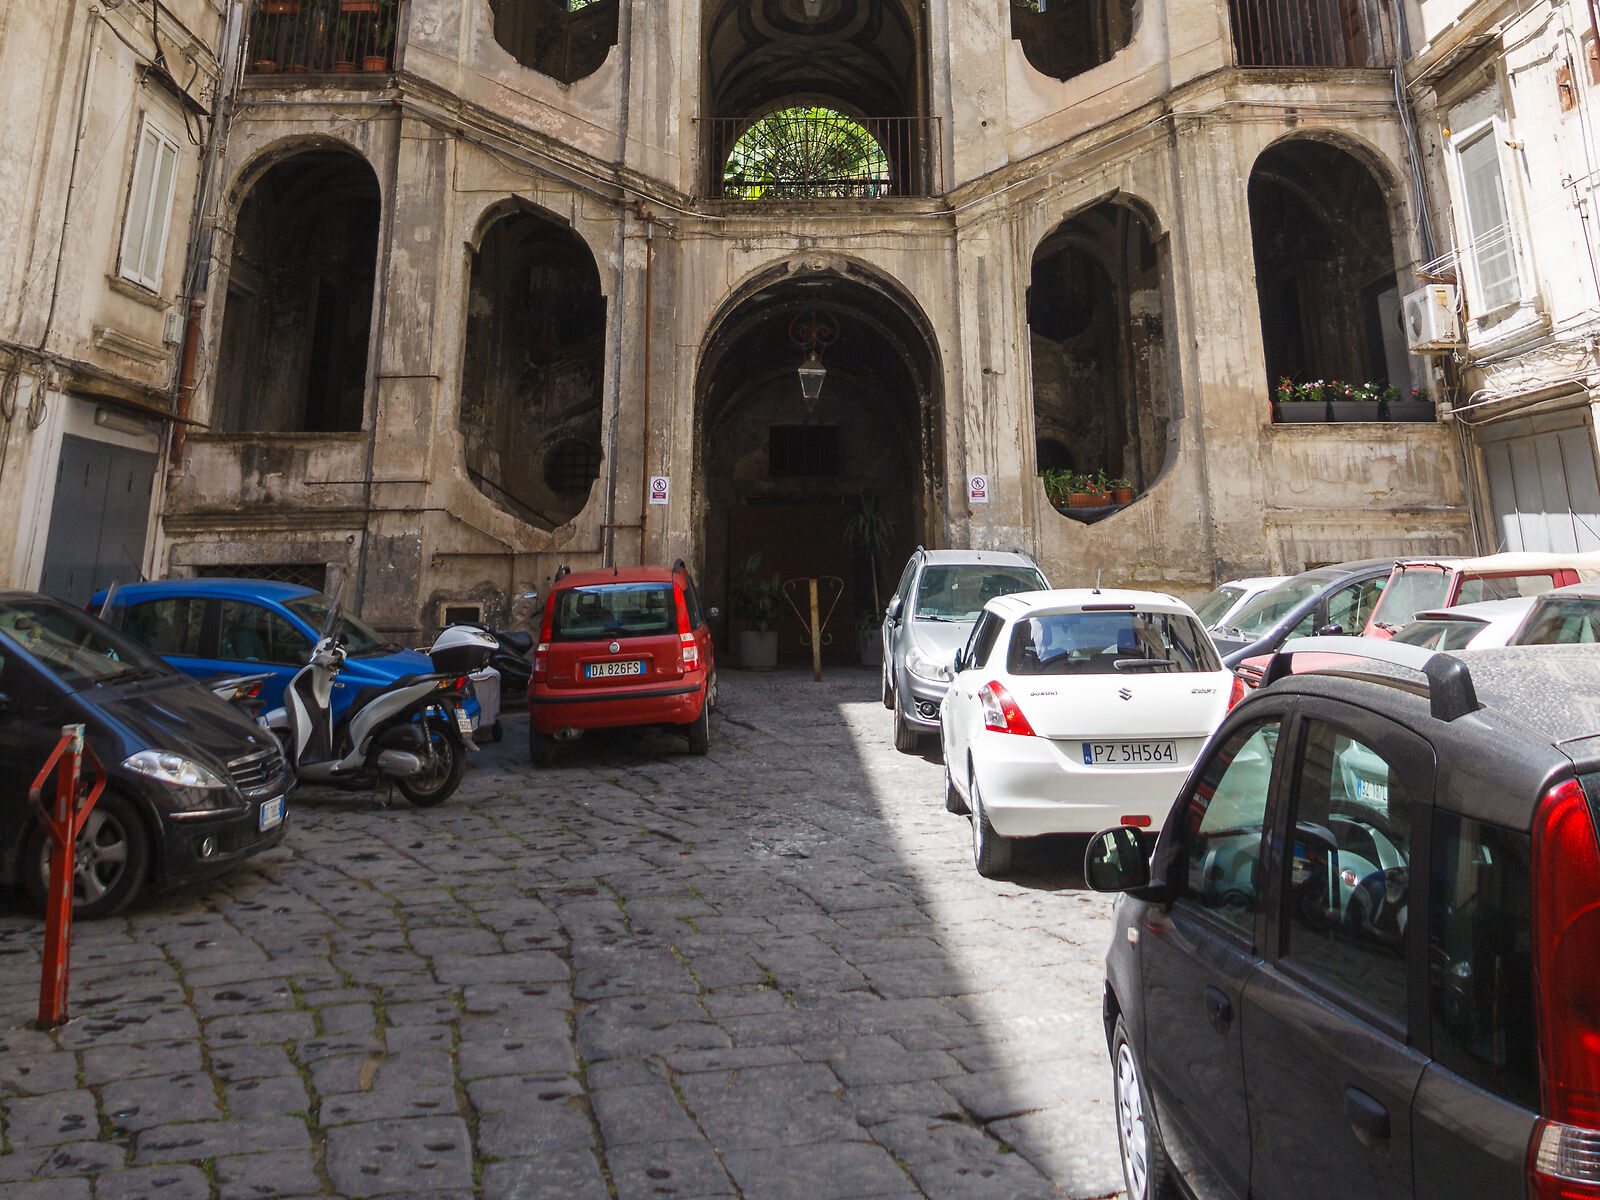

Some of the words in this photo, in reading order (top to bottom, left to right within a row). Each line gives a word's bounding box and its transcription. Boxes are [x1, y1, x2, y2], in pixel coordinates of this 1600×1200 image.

[592, 664, 604, 676] DA
[608, 662, 639, 675] 826FS
[1094, 745, 1116, 762] PZ
[1121, 744, 1173, 761] 5H564
